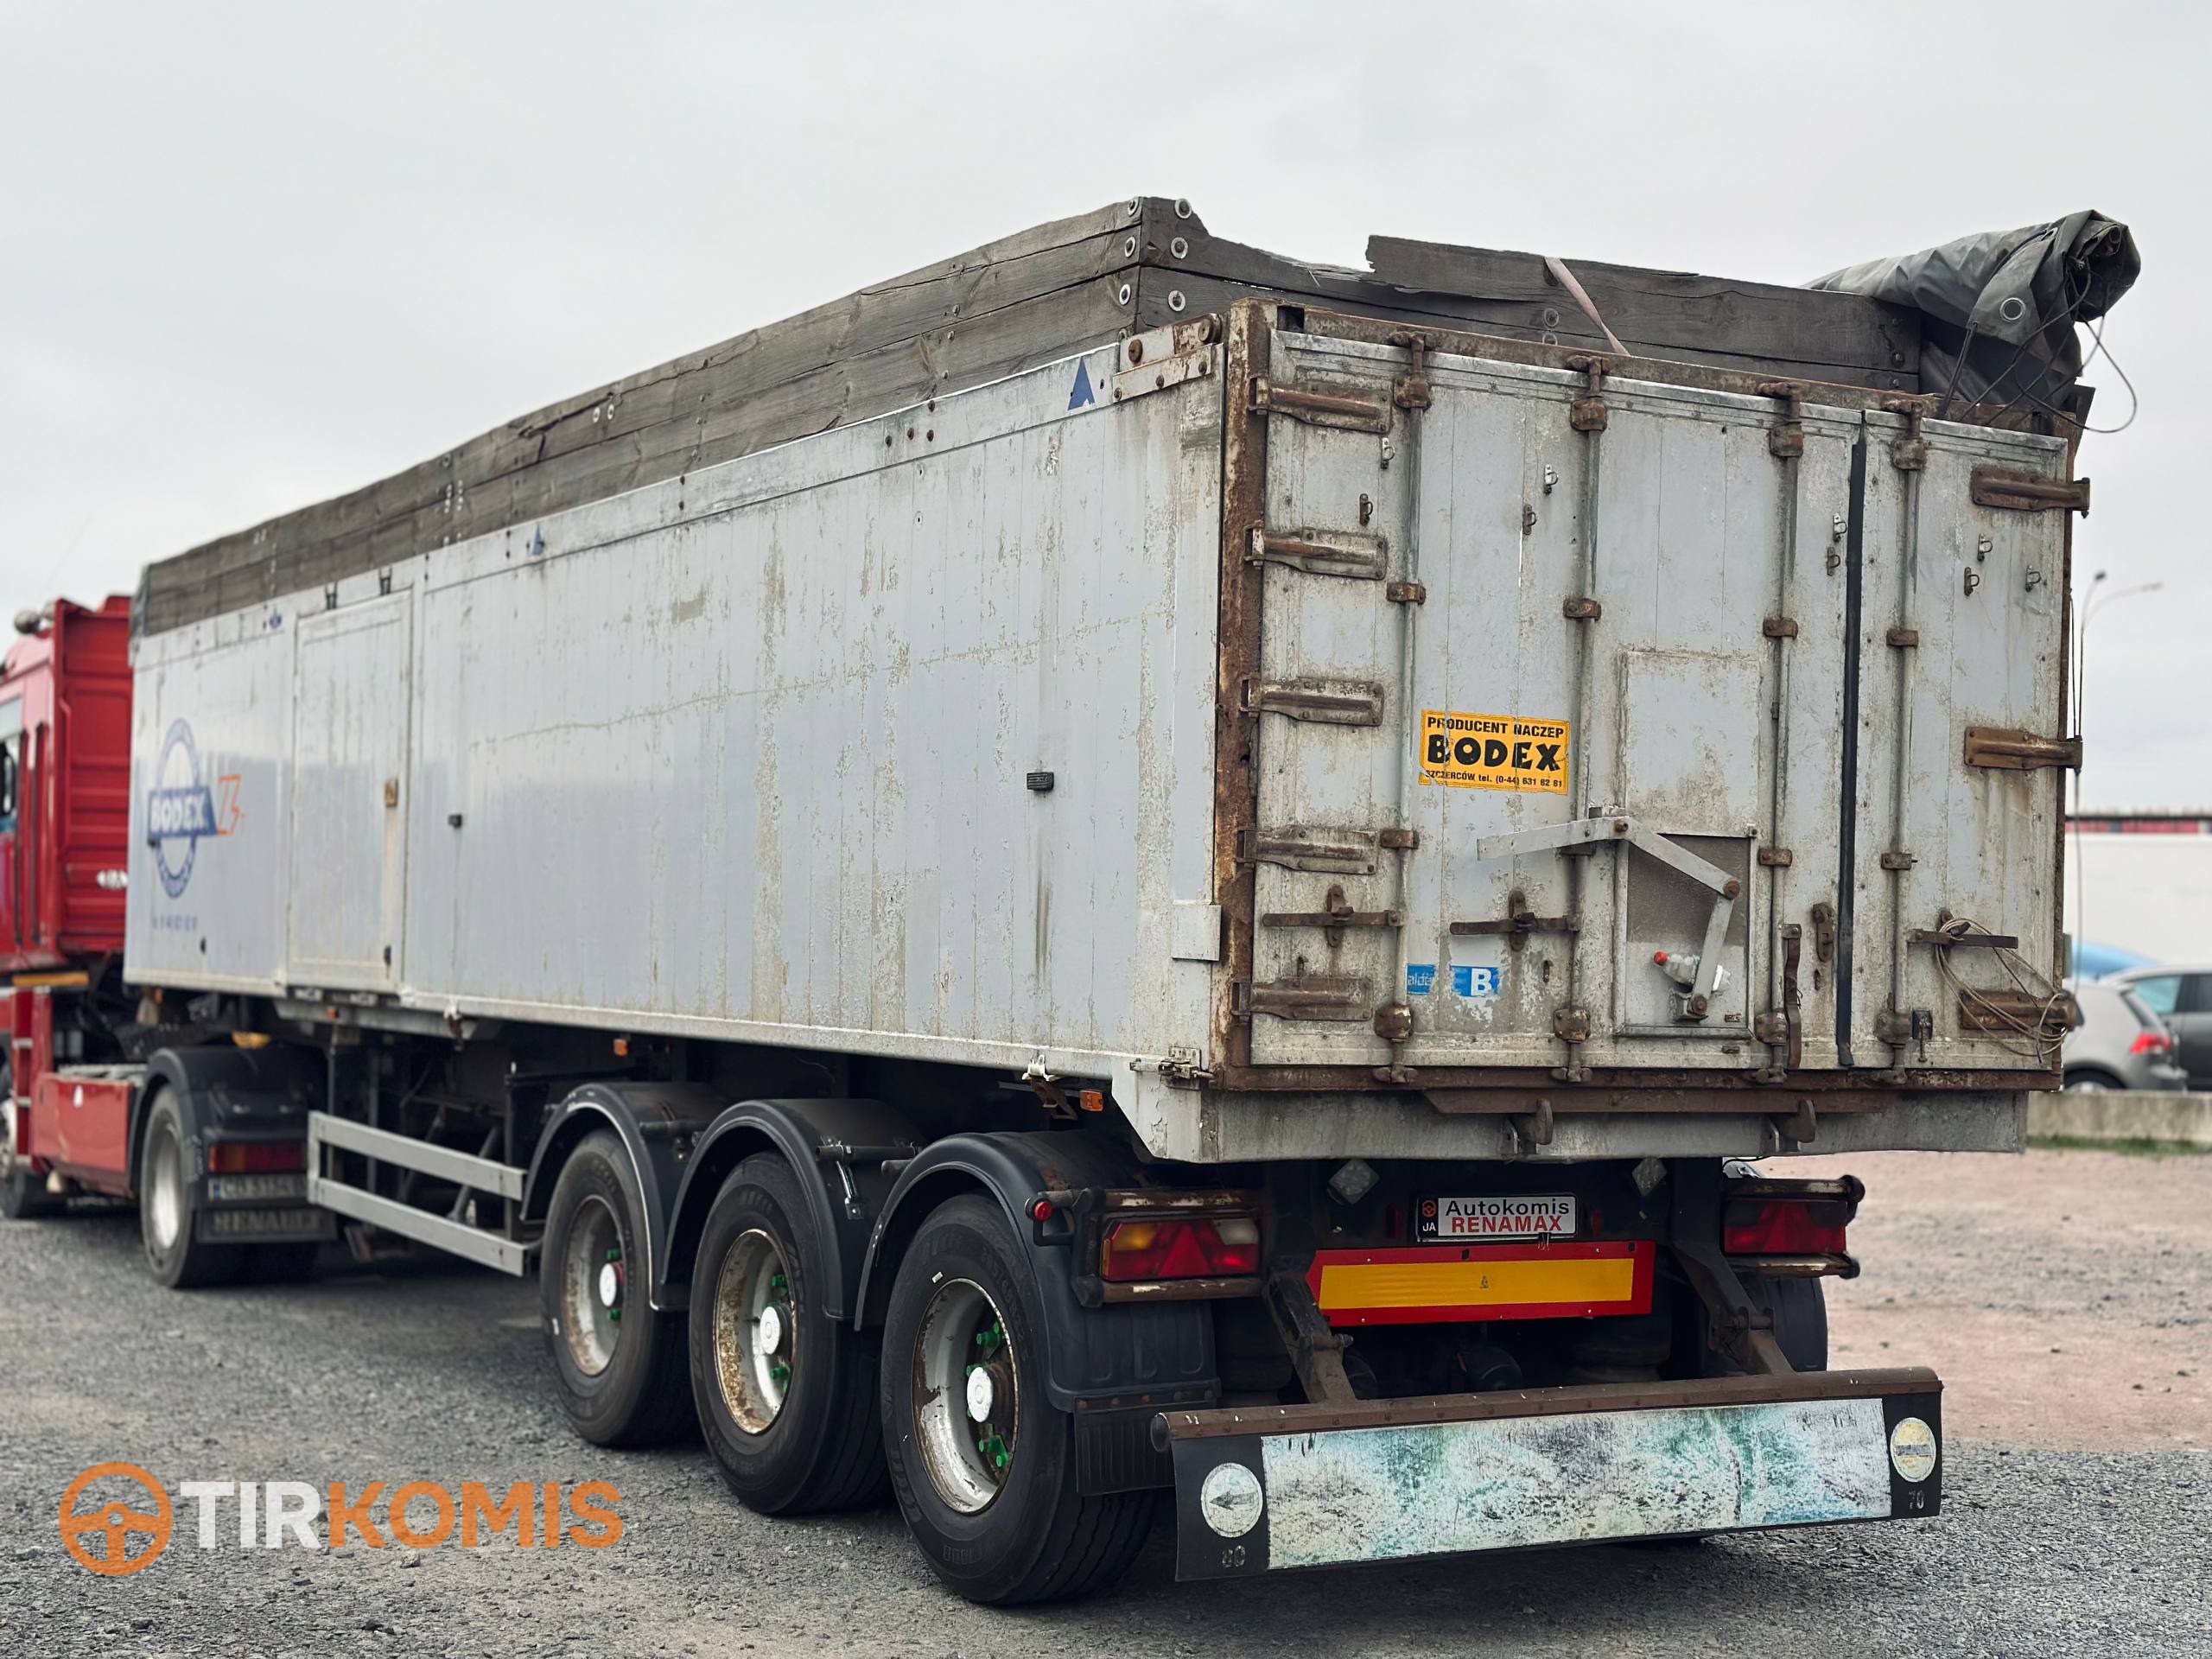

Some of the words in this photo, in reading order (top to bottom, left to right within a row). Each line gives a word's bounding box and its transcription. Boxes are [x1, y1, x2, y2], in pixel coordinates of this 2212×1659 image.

[1427, 717, 1508, 734] PRODUCENT
[1514, 724, 1564, 738] NACZEP
[1427, 734, 1560, 772] BODEX
[149, 795, 210, 835] BODEX
[1446, 1198, 1570, 1217] Autokomis
[1422, 1222, 1437, 1232] JA
[1451, 1216, 1563, 1233] RENAMAX
